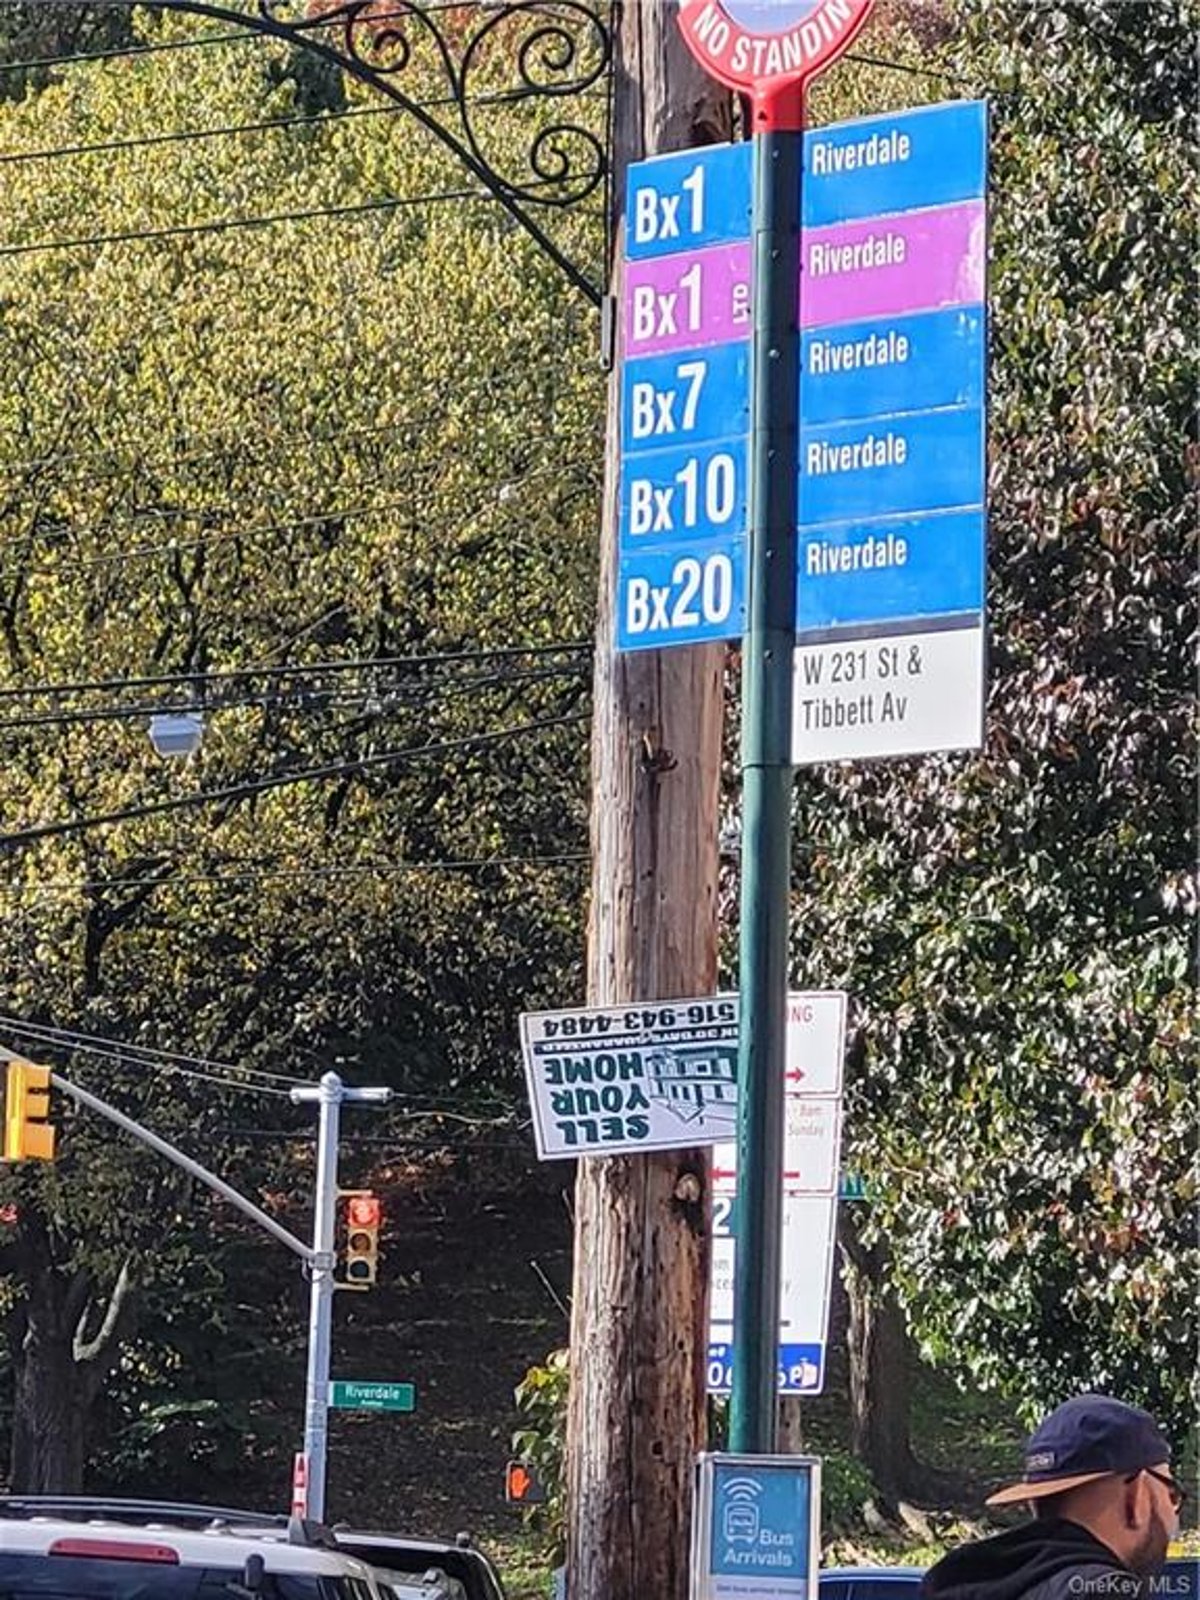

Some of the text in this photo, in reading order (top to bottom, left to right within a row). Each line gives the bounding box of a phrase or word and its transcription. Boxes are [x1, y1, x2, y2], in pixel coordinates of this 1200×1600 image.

[693, 0, 852, 76] NO STANDIN
[812, 131, 910, 176] Riverdale
[635, 166, 704, 243] Bx1
[810, 233, 905, 277] Riverdale
[633, 264, 748, 341] Bx1 LTD
[809, 331, 909, 375] Riverdale
[632, 361, 707, 438] Bx7
[807, 432, 906, 476] Riverdale
[630, 454, 735, 535] Bx10
[807, 533, 907, 575] Riverdale
[627, 554, 732, 633] Bx20
[803, 645, 922, 684] W 231 St &
[803, 693, 907, 729] Tibbett Av
[543, 1002, 735, 1038] 516-943-4484
[545, 1052, 644, 1084] HOME
[551, 1083, 650, 1115] YOUR
[556, 1114, 650, 1146] SELL
[345, 1385, 400, 1400] Riverdale
[724, 1548, 793, 1567] Arrivals
[760, 1529, 794, 1545] Bus
